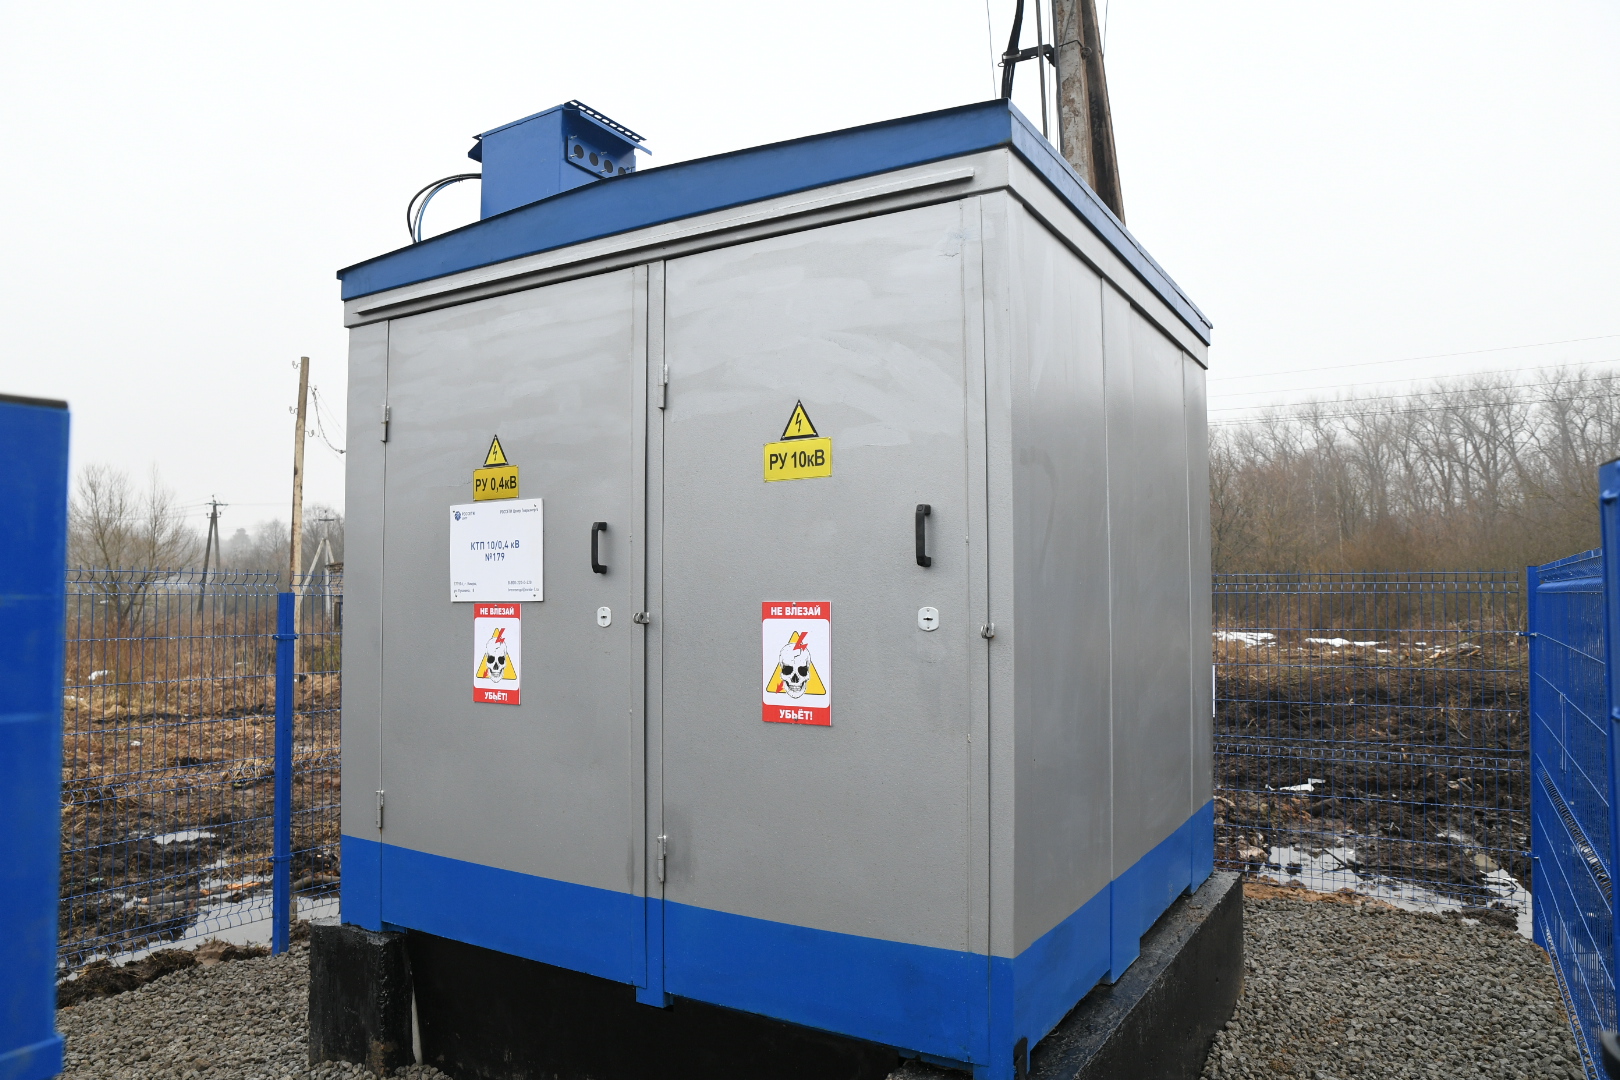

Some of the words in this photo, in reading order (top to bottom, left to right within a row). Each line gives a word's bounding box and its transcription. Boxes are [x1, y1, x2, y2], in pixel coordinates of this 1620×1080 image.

[769, 452, 788, 471] РУ
[791, 449, 826, 469] 10кВ
[475, 478, 488, 492] РУ
[490, 475, 517, 493] 0,4кВ
[470, 541, 485, 551] КТП
[486, 540, 509, 551] 10/0,4
[510, 539, 520, 549] кВ
[484, 552, 505, 562] №179
[479, 607, 489, 615] НЕ
[489, 606, 515, 615] ВЛЕЗАЙ
[770, 606, 783, 616] НЕ
[784, 605, 821, 616] ВЛЕЗАЙ
[484, 691, 508, 702] УБЬЁТ!
[779, 708, 813, 720] УБЬЁТ!
